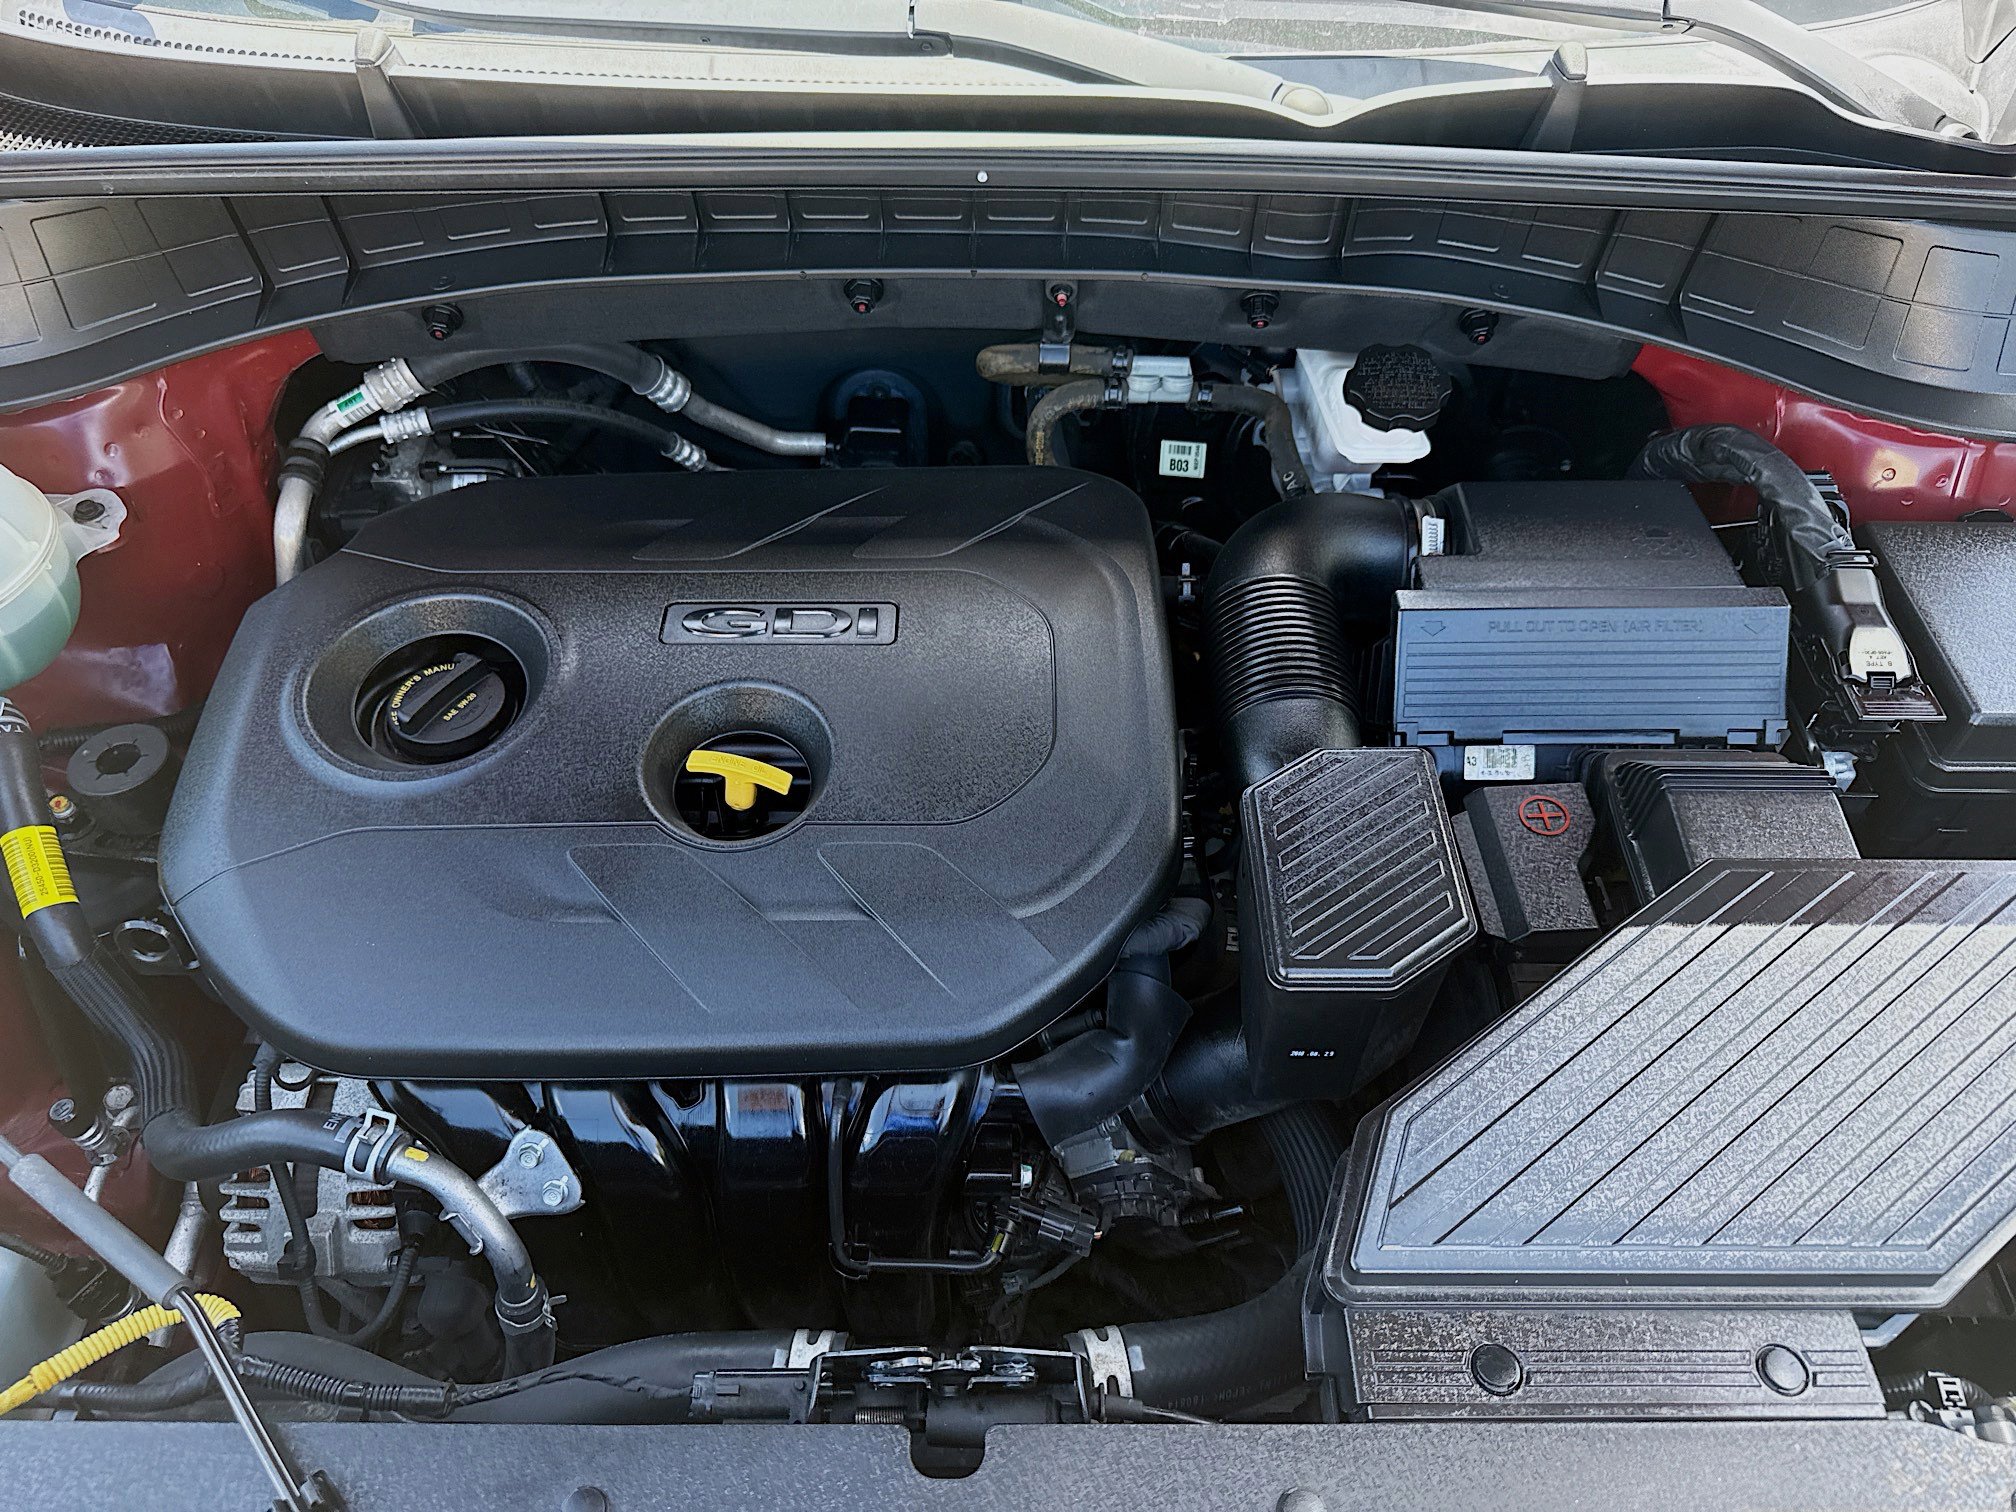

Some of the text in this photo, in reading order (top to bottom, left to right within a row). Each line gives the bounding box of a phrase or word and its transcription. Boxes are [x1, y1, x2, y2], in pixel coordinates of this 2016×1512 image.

[1169, 458, 1189, 472] B03
[681, 607, 878, 638] GDI
[1487, 620, 1523, 633] PULL
[1526, 620, 1555, 632] OUT
[1558, 620, 1575, 632] TO
[1580, 620, 1617, 633] OPEN
[391, 674, 422, 709] OWNER'S
[443, 692, 477, 722] SAE 5W-20
[711, 754, 768, 775] ENGINE OIL
